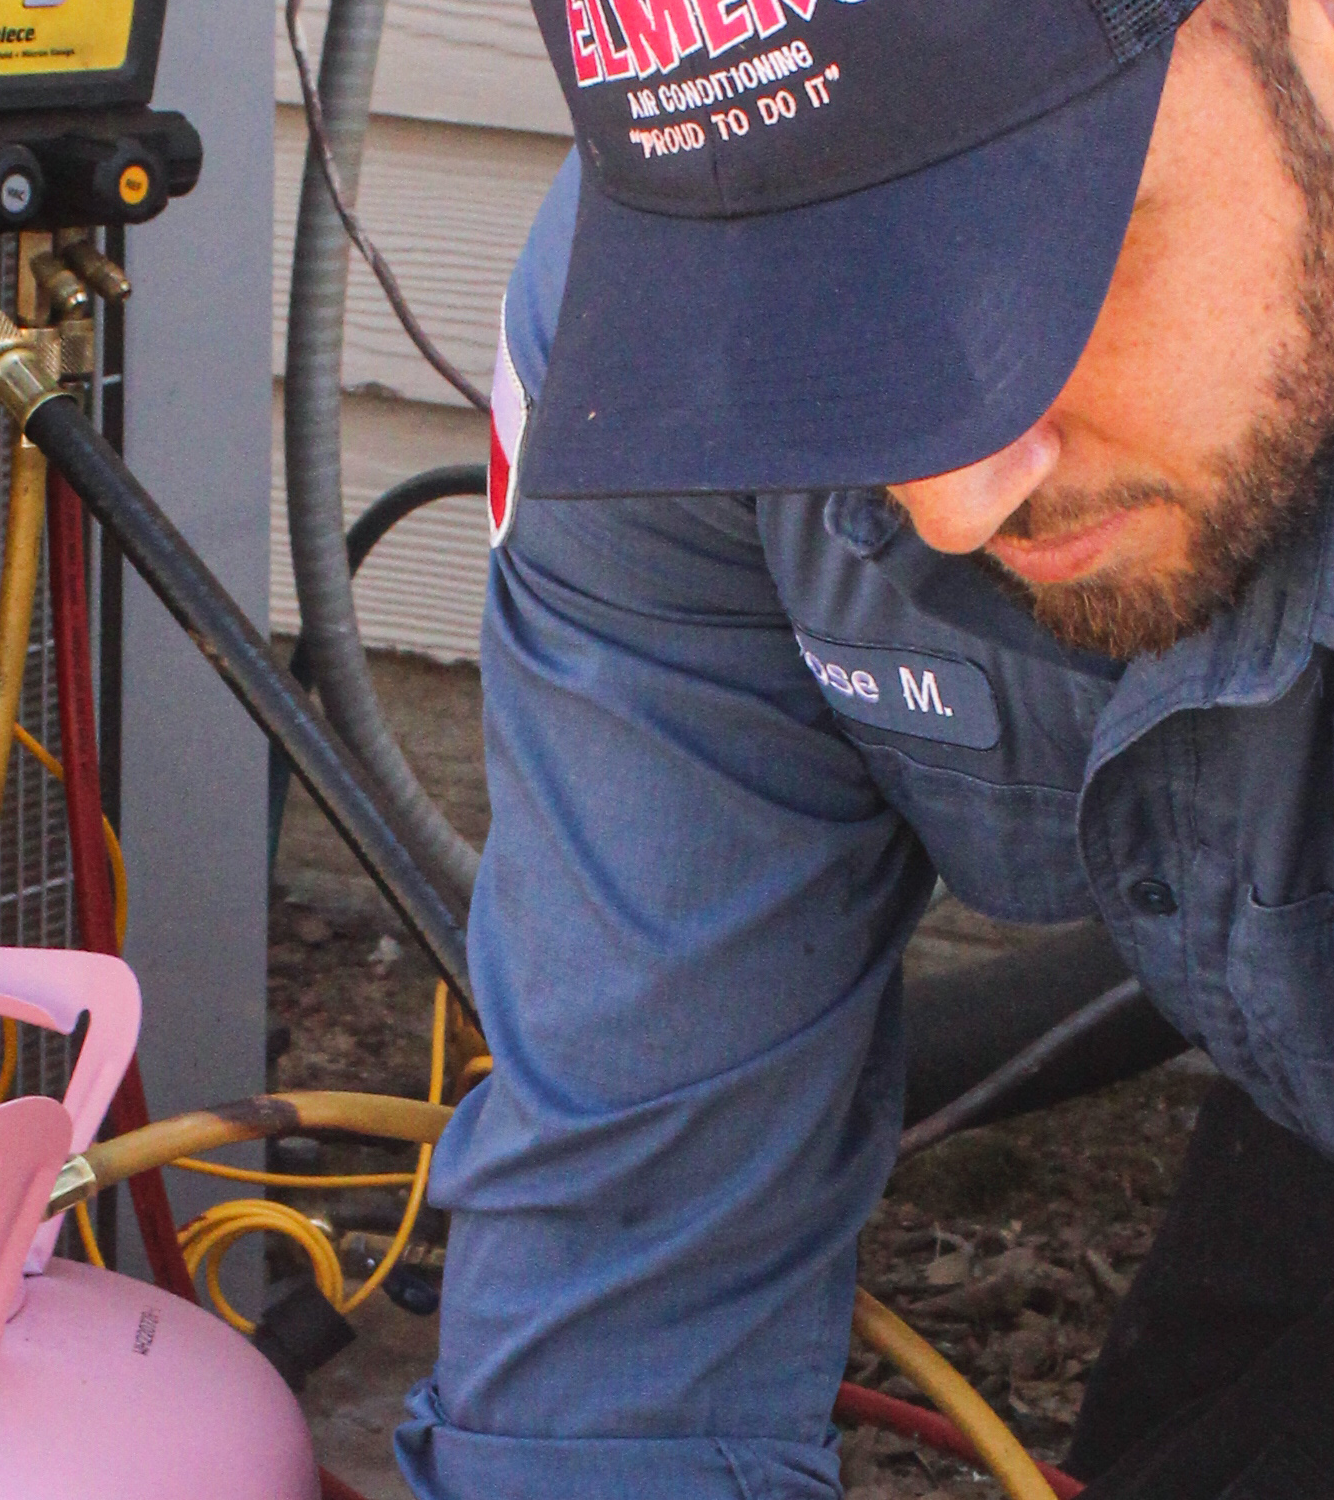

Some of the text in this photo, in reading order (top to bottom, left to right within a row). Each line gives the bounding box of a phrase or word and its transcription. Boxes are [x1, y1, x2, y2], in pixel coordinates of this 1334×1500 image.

[628, 39, 814, 120] AIR CONDITIONING
[717, 109, 750, 145] TO
[762, 94, 797, 129] DO
[899, 665, 954, 717] M.
